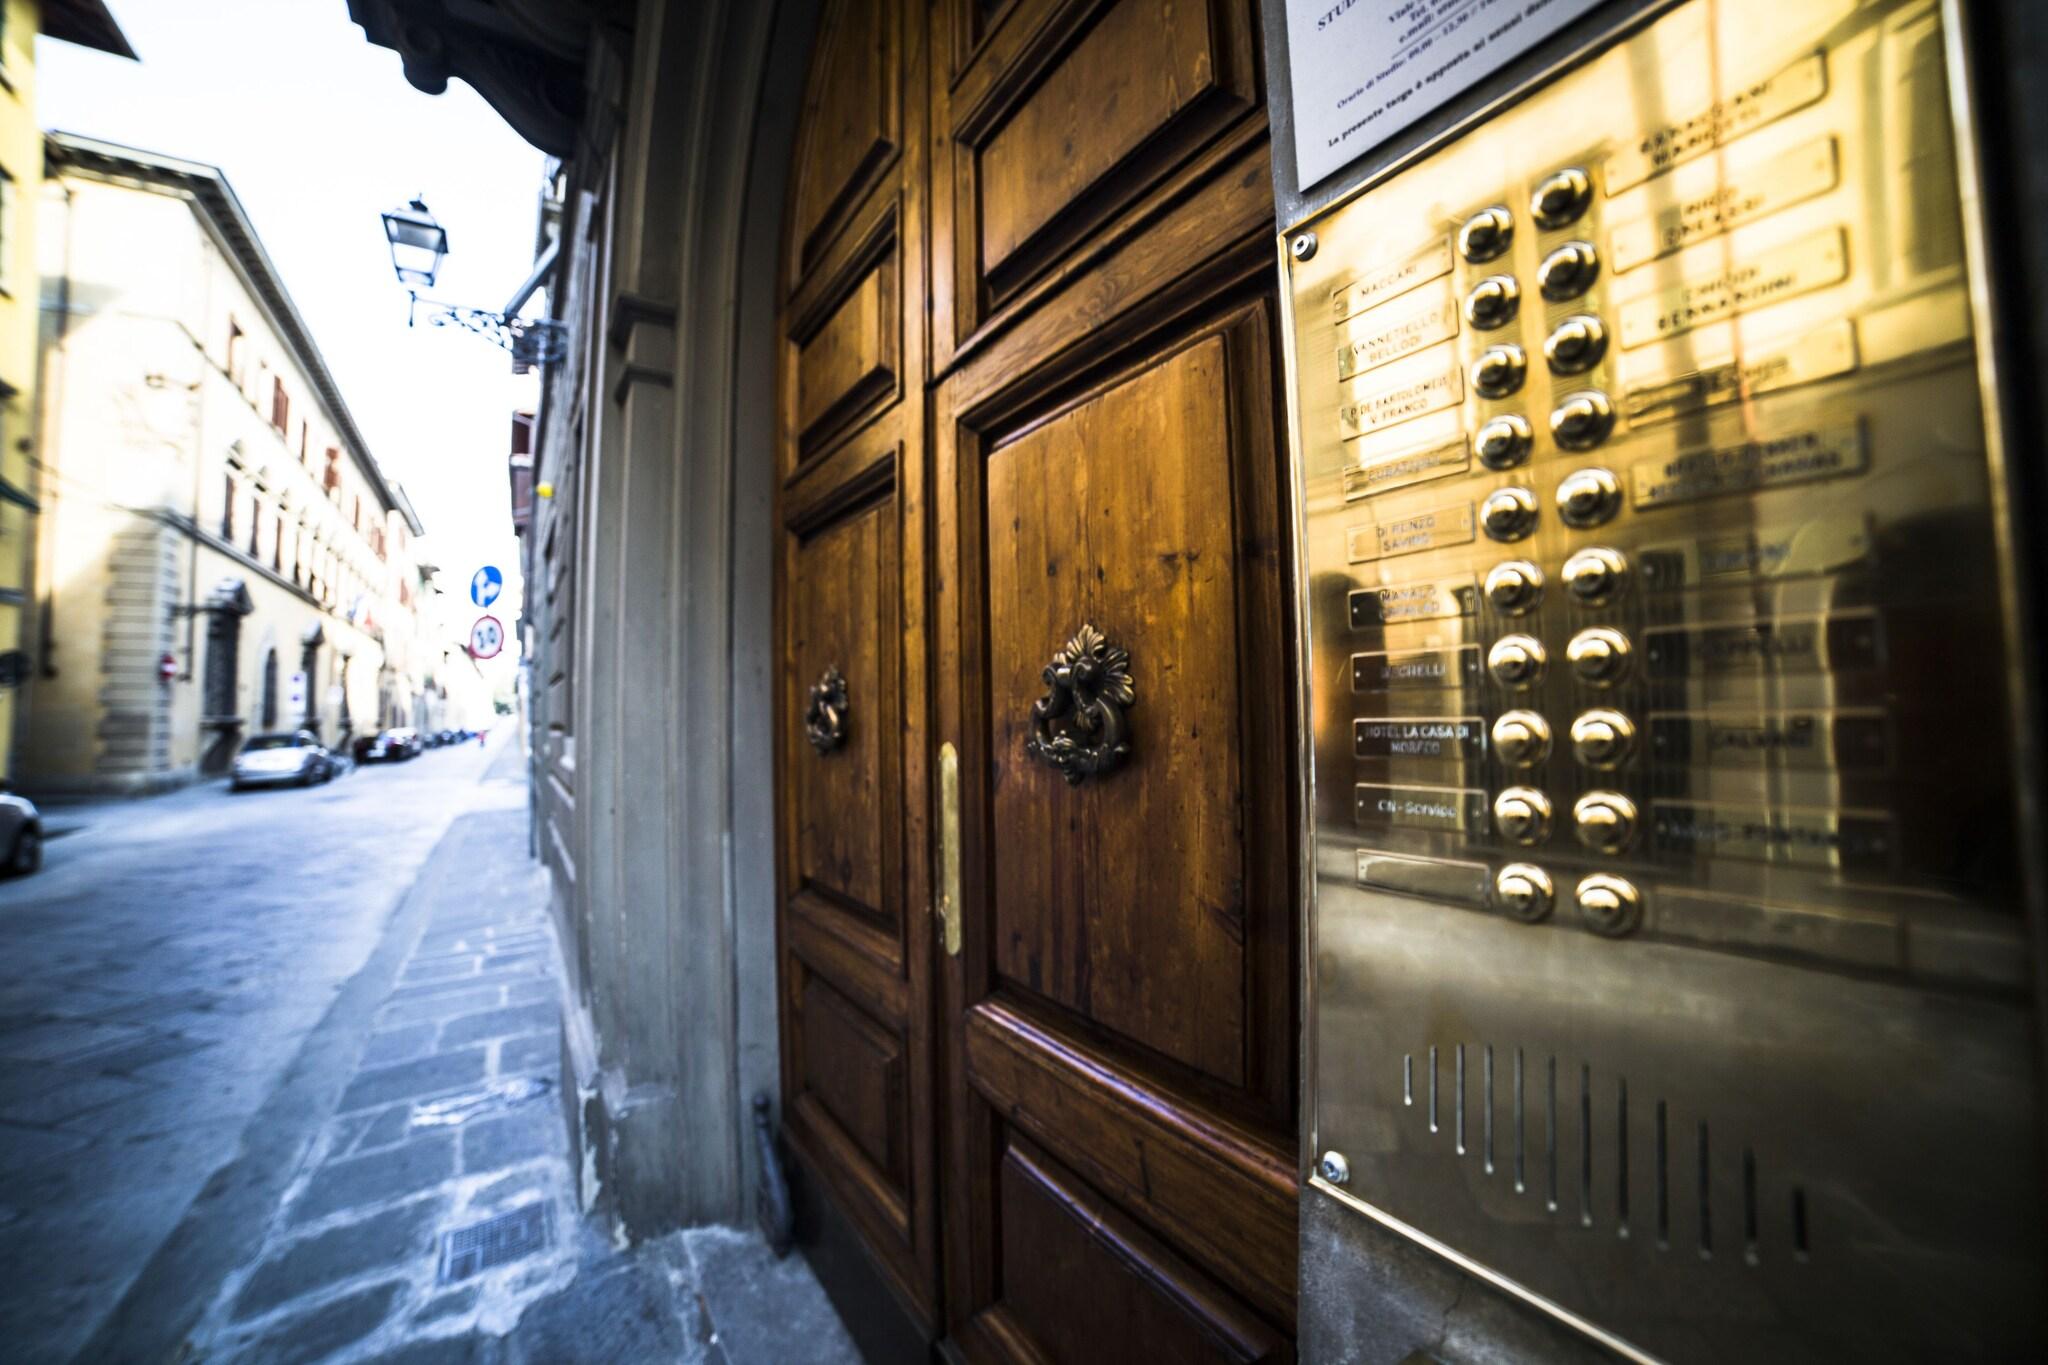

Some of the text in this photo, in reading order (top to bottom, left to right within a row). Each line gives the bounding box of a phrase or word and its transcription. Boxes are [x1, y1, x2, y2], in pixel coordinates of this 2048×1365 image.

[1328, 137, 1339, 147] La
[1342, 108, 1383, 141] presente
[1386, 88, 1413, 109] targa
[1361, 265, 1417, 297] MACCARI
[1383, 398, 1427, 420] FRANCO
[1392, 515, 1435, 534] RENZO
[1364, 724, 1401, 738] HOTEL
[1402, 725, 1419, 738] LA
[1420, 725, 1455, 738] CASA
